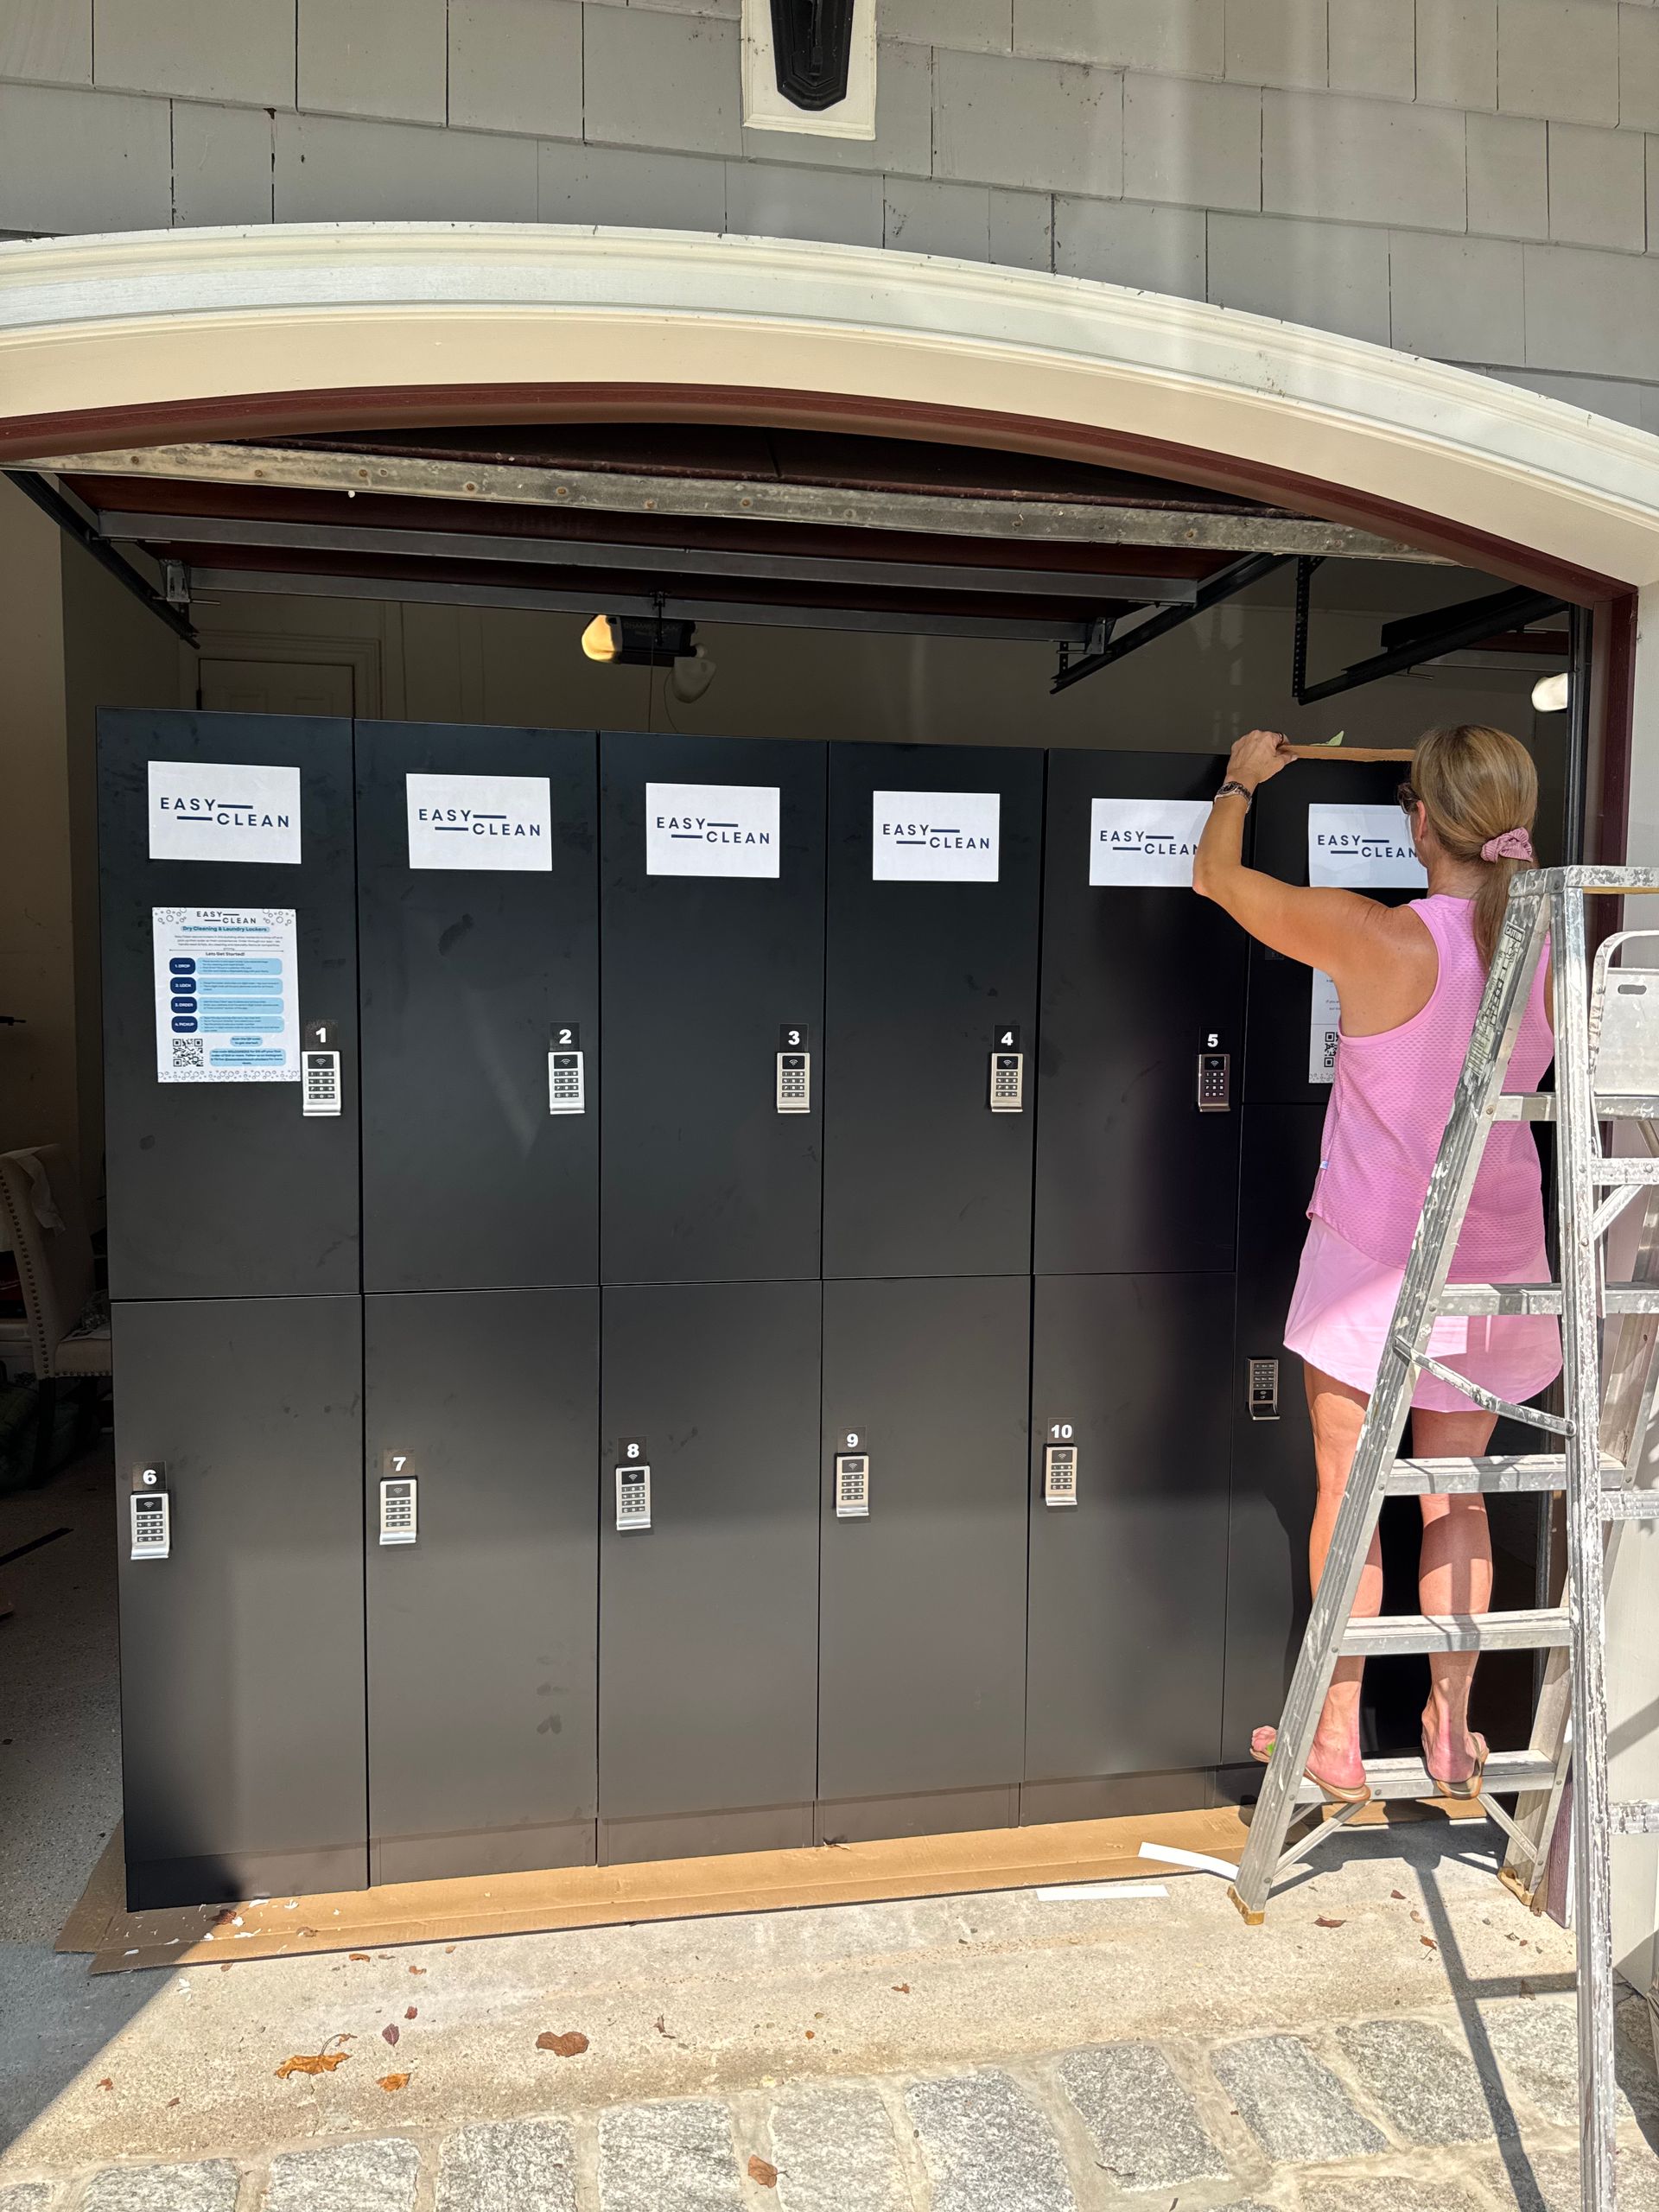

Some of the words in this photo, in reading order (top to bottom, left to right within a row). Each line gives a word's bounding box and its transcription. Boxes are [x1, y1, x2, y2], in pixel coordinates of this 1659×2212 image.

[161, 797, 216, 810] EASY
[216, 812, 289, 828] CLEAN
[419, 808, 472, 822] EASY
[473, 823, 541, 836] CLEAN
[657, 817, 706, 830] EASY
[882, 823, 930, 836] EASY
[706, 830, 770, 844] CLEAN
[929, 836, 989, 849] CLEAN
[1100, 830, 1145, 842] EASY
[1317, 834, 1361, 846] EASY
[1361, 846, 1417, 858] CLEAN
[316, 1028, 327, 1043] 1
[560, 1029, 572, 1045] 2
[788, 1031, 800, 1046] 3
[1001, 1032, 1014, 1046] 4
[1207, 1034, 1218, 1047] 5
[1051, 1424, 1073, 1439] 10
[847, 1433, 859, 1448] 9
[626, 1444, 639, 1459] 8
[392, 1457, 407, 1472] 7
[143, 1470, 157, 1485] 6
